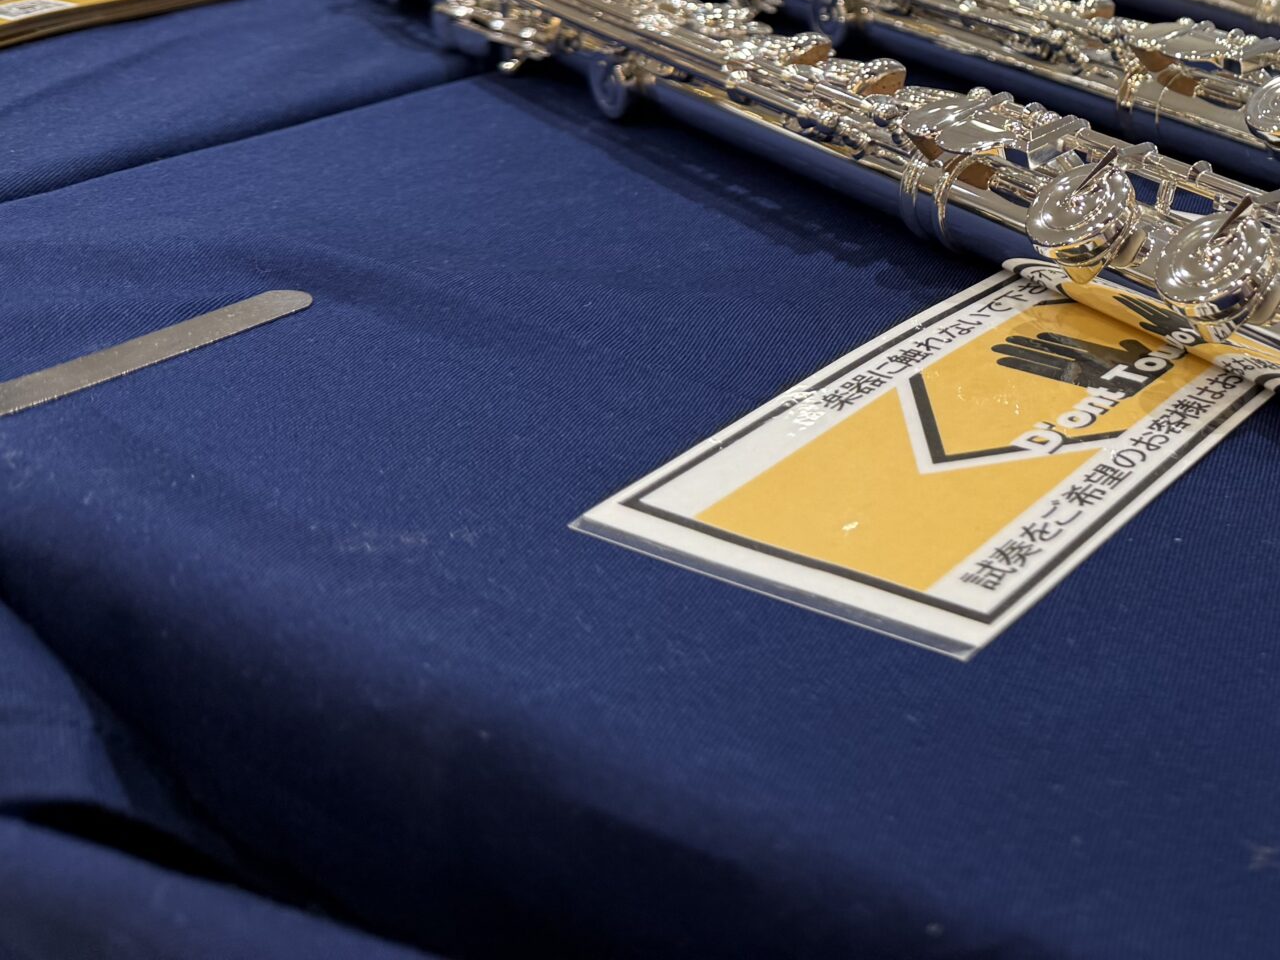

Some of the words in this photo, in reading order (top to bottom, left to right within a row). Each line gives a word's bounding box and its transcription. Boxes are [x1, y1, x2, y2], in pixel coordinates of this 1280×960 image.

[822, 281, 1049, 412] 楽器に触れないで下さ
[1100, 342, 1188, 383] Tou
[960, 371, 1245, 591] 試奏をご希望のお客様はお
